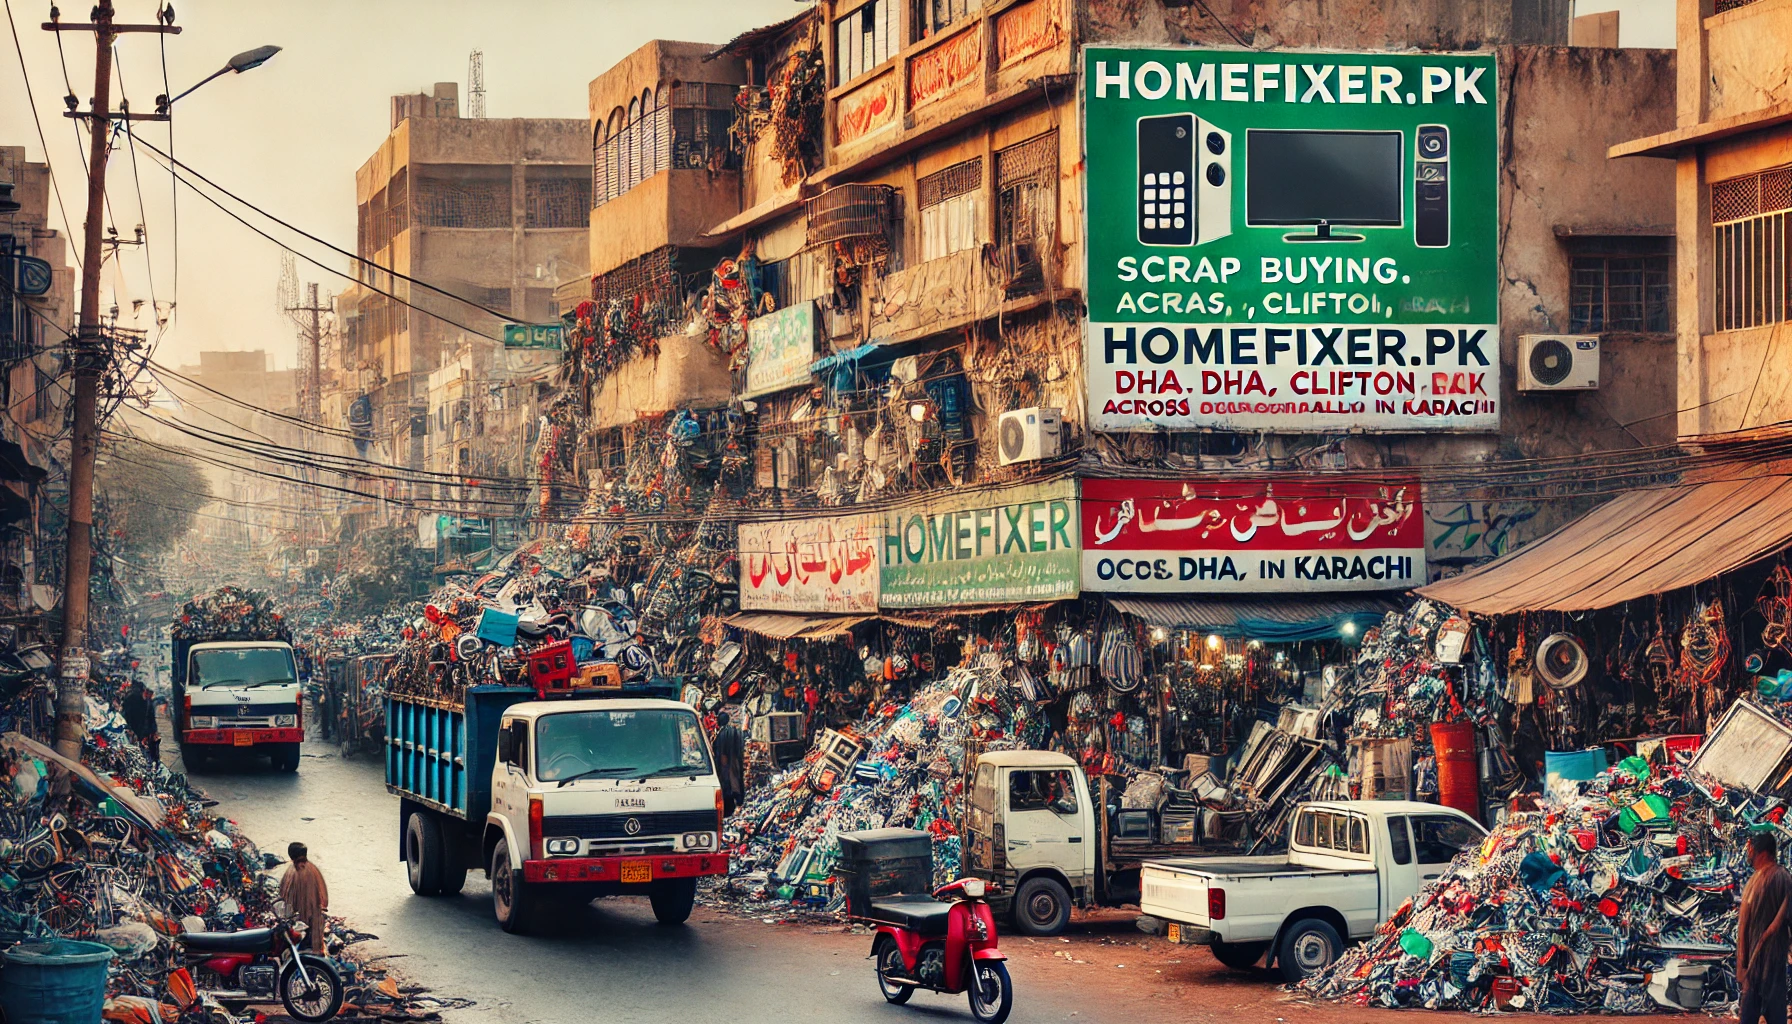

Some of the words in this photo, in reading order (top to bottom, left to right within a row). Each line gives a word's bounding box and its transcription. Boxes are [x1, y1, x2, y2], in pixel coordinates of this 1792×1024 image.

[1095, 61, 1487, 105] HOMEFIXER.PK
[1117, 256, 1241, 284] SCRAP
[1261, 256, 1410, 284] BUYING.
[1104, 327, 1490, 366] HOMEFIXER.PK
[1201, 370, 1277, 397] DHA,
[1375, 400, 1396, 414] IN
[884, 500, 1071, 565] HOMEFIXER
[1178, 556, 1247, 581] DHA,
[1260, 559, 1285, 579] IN
[1294, 555, 1412, 580] KARACHI
